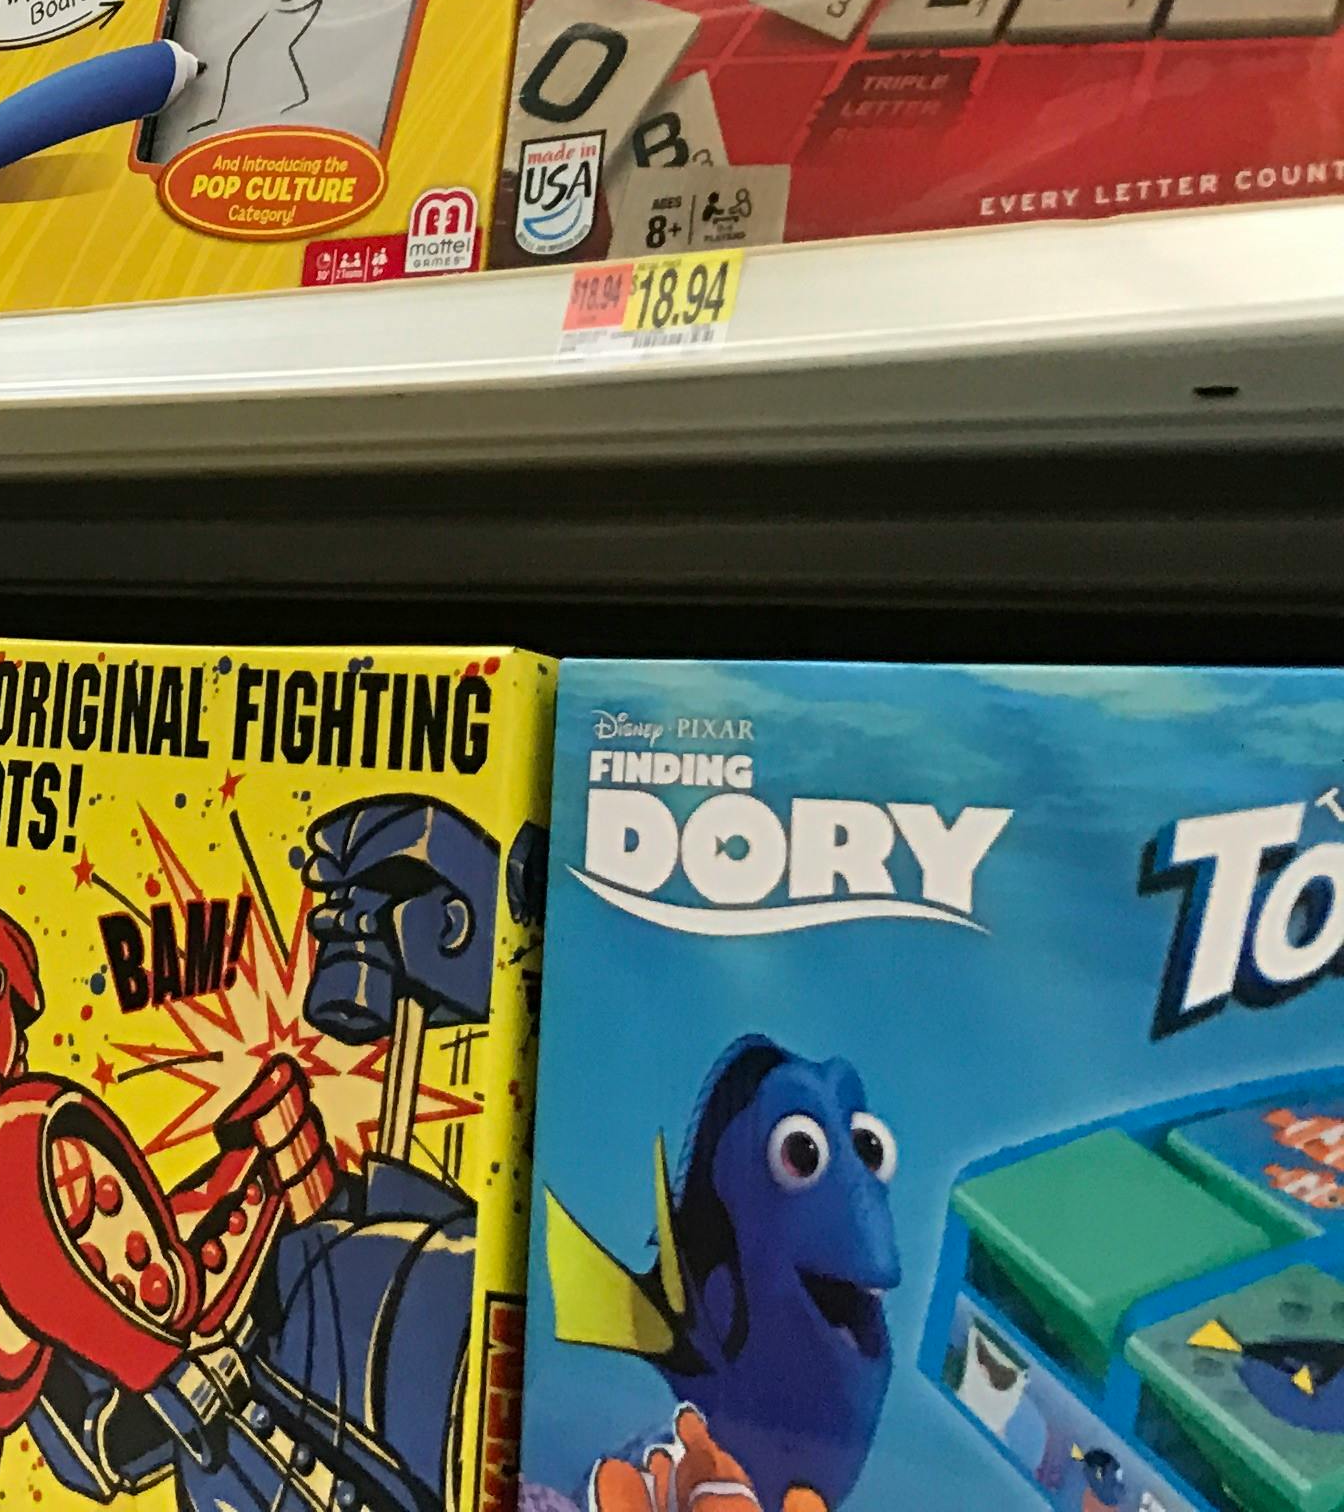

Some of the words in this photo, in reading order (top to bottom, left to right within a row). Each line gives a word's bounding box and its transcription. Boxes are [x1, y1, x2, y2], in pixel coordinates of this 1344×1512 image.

[212, 155, 239, 171] And
[242, 155, 322, 175] Introducing
[325, 156, 348, 172] the
[527, 147, 572, 165] made
[580, 142, 597, 157] in
[191, 175, 241, 199] POP
[246, 177, 356, 204] CULTURE
[524, 160, 592, 212] USA
[651, 195, 682, 211] AGES
[980, 189, 1079, 216] EVERY
[1094, 177, 1218, 206] LETTER
[228, 205, 296, 224] Category!
[645, 215, 682, 249] 8+
[409, 238, 471, 258] mattel
[231, 671, 490, 774] FIGHTING
[591, 710, 664, 747] Disney
[677, 718, 755, 740] PIXAR
[590, 750, 753, 788] FINDING
[585, 789, 1014, 914] DORY
[102, 896, 250, 1012] BAM!
